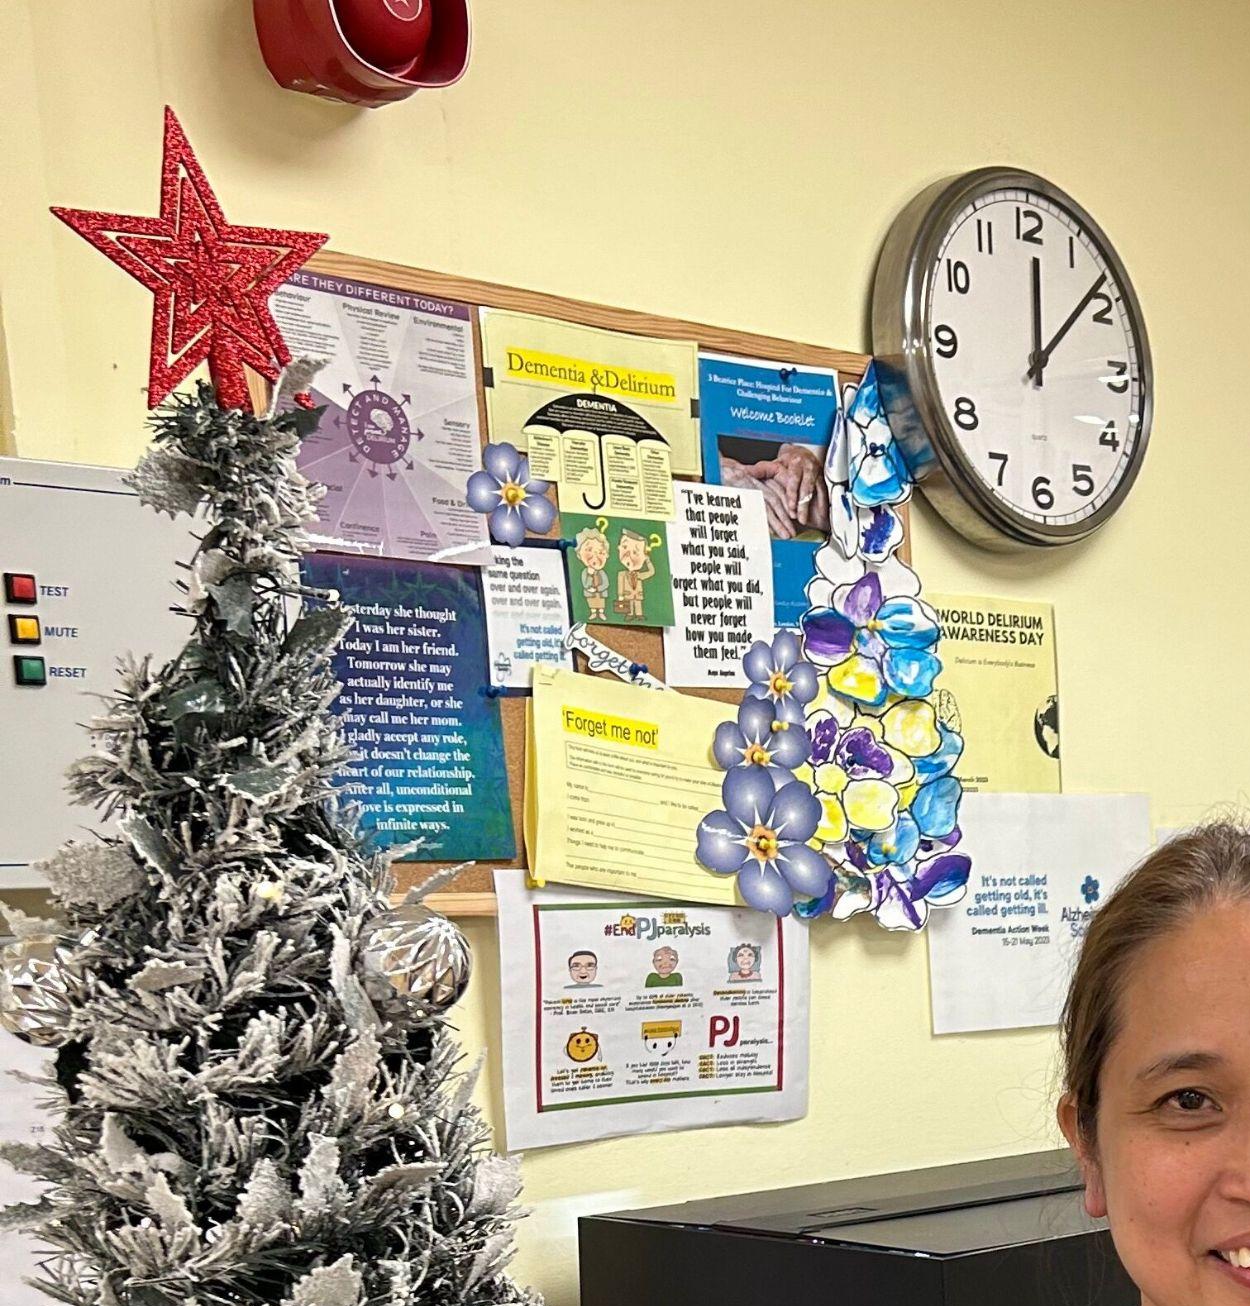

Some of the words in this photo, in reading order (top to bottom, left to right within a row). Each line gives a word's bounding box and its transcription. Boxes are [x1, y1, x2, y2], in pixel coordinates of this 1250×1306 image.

[1016, 207, 1043, 245] 12
[977, 219, 993, 254] 11
[946, 258, 970, 294] 10
[313, 276, 343, 293] THEY
[346, 285, 411, 307] DIFFERENT
[413, 299, 454, 314] TODAY?
[342, 302, 373, 315] Physical
[374, 308, 400, 320] Review
[1093, 292, 1113, 325] 2
[934, 325, 958, 358] 9
[507, 352, 586, 383] Dementia
[1107, 361, 1129, 393] 3
[577, 399, 617, 412] DEMENTIA
[954, 397, 979, 430] 8
[730, 406, 775, 423] Welcome
[775, 412, 815, 427] Booklet
[1100, 420, 1120, 452] 4
[988, 452, 1008, 486] 7
[1072, 464, 1094, 497] 5
[706, 492, 742, 508] learned
[1032, 476, 1054, 510] 6
[686, 507, 706, 522] that
[709, 511, 738, 526] people
[690, 525, 707, 539] will
[711, 526, 738, 543] forget
[681, 541, 705, 556] what
[708, 545, 724, 559] you
[727, 545, 749, 561] said,
[690, 560, 721, 575] people
[725, 561, 741, 576] will
[40, 585, 68, 598] TEST
[671, 578, 697, 591] orget
[701, 576, 724, 592] what
[727, 580, 743, 595] you
[746, 579, 763, 595] did,
[683, 593, 699, 607] but
[702, 594, 732, 610] people
[736, 596, 752, 610] will
[691, 612, 717, 625] never
[720, 612, 746, 628] forget
[937, 609, 984, 625] WORLD
[988, 613, 1043, 630] DELIRIUM
[44, 626, 78, 638] MUTE
[355, 620, 360, 632] I
[363, 624, 385, 634] was
[386, 622, 405, 635] her
[408, 624, 441, 638] sister.
[686, 627, 704, 641] how
[708, 630, 724, 643] you
[728, 629, 752, 643] made
[940, 626, 1016, 644] AWARENESS
[1019, 631, 1044, 646] DAY
[340, 639, 372, 654] Today
[375, 640, 379, 652] I
[382, 643, 399, 653] am
[401, 641, 420, 654] her
[423, 642, 459, 656] friend.
[565, 622, 628, 673] forget
[694, 645, 718, 659] them
[49, 666, 87, 679] RESET
[347, 656, 406, 672] Tomorrow
[409, 659, 427, 673] she
[429, 665, 452, 676] may
[347, 675, 391, 691] actually
[393, 676, 435, 693] identify
[437, 682, 454, 691] me
[339, 695, 352, 704] as
[354, 692, 374, 705] her
[376, 693, 428, 709] daughter,
[431, 699, 442, 707] or
[445, 696, 463, 709] she
[343, 714, 366, 726] may
[369, 711, 389, 724] call
[391, 715, 408, 725] me
[410, 713, 430, 726] her
[431, 717, 462, 726] mom.
[348, 728, 382, 744] gladly
[384, 732, 419, 745] accept
[421, 734, 440, 746] any
[442, 732, 467, 746] role,
[611, 725, 631, 740] me
[371, 765, 383, 777] of
[384, 768, 405, 777] our
[407, 765, 475, 782] relationship.
[376, 818, 418, 830] infinite
[420, 822, 450, 832] ways.
[982, 875, 998, 887] It's
[1000, 876, 1017, 886] not
[1018, 874, 1047, 886] called
[974, 890, 1012, 904] getting
[1014, 890, 1032, 901] old,
[1034, 888, 1048, 900] it's
[966, 904, 998, 916] called
[1000, 904, 1035, 918] getting
[1037, 903, 1048, 914] ill.
[972, 926, 1006, 935] Dementia
[1008, 925, 1030, 934] Action
[1031, 924, 1049, 933] Week
[709, 1016, 739, 1048] PJ
